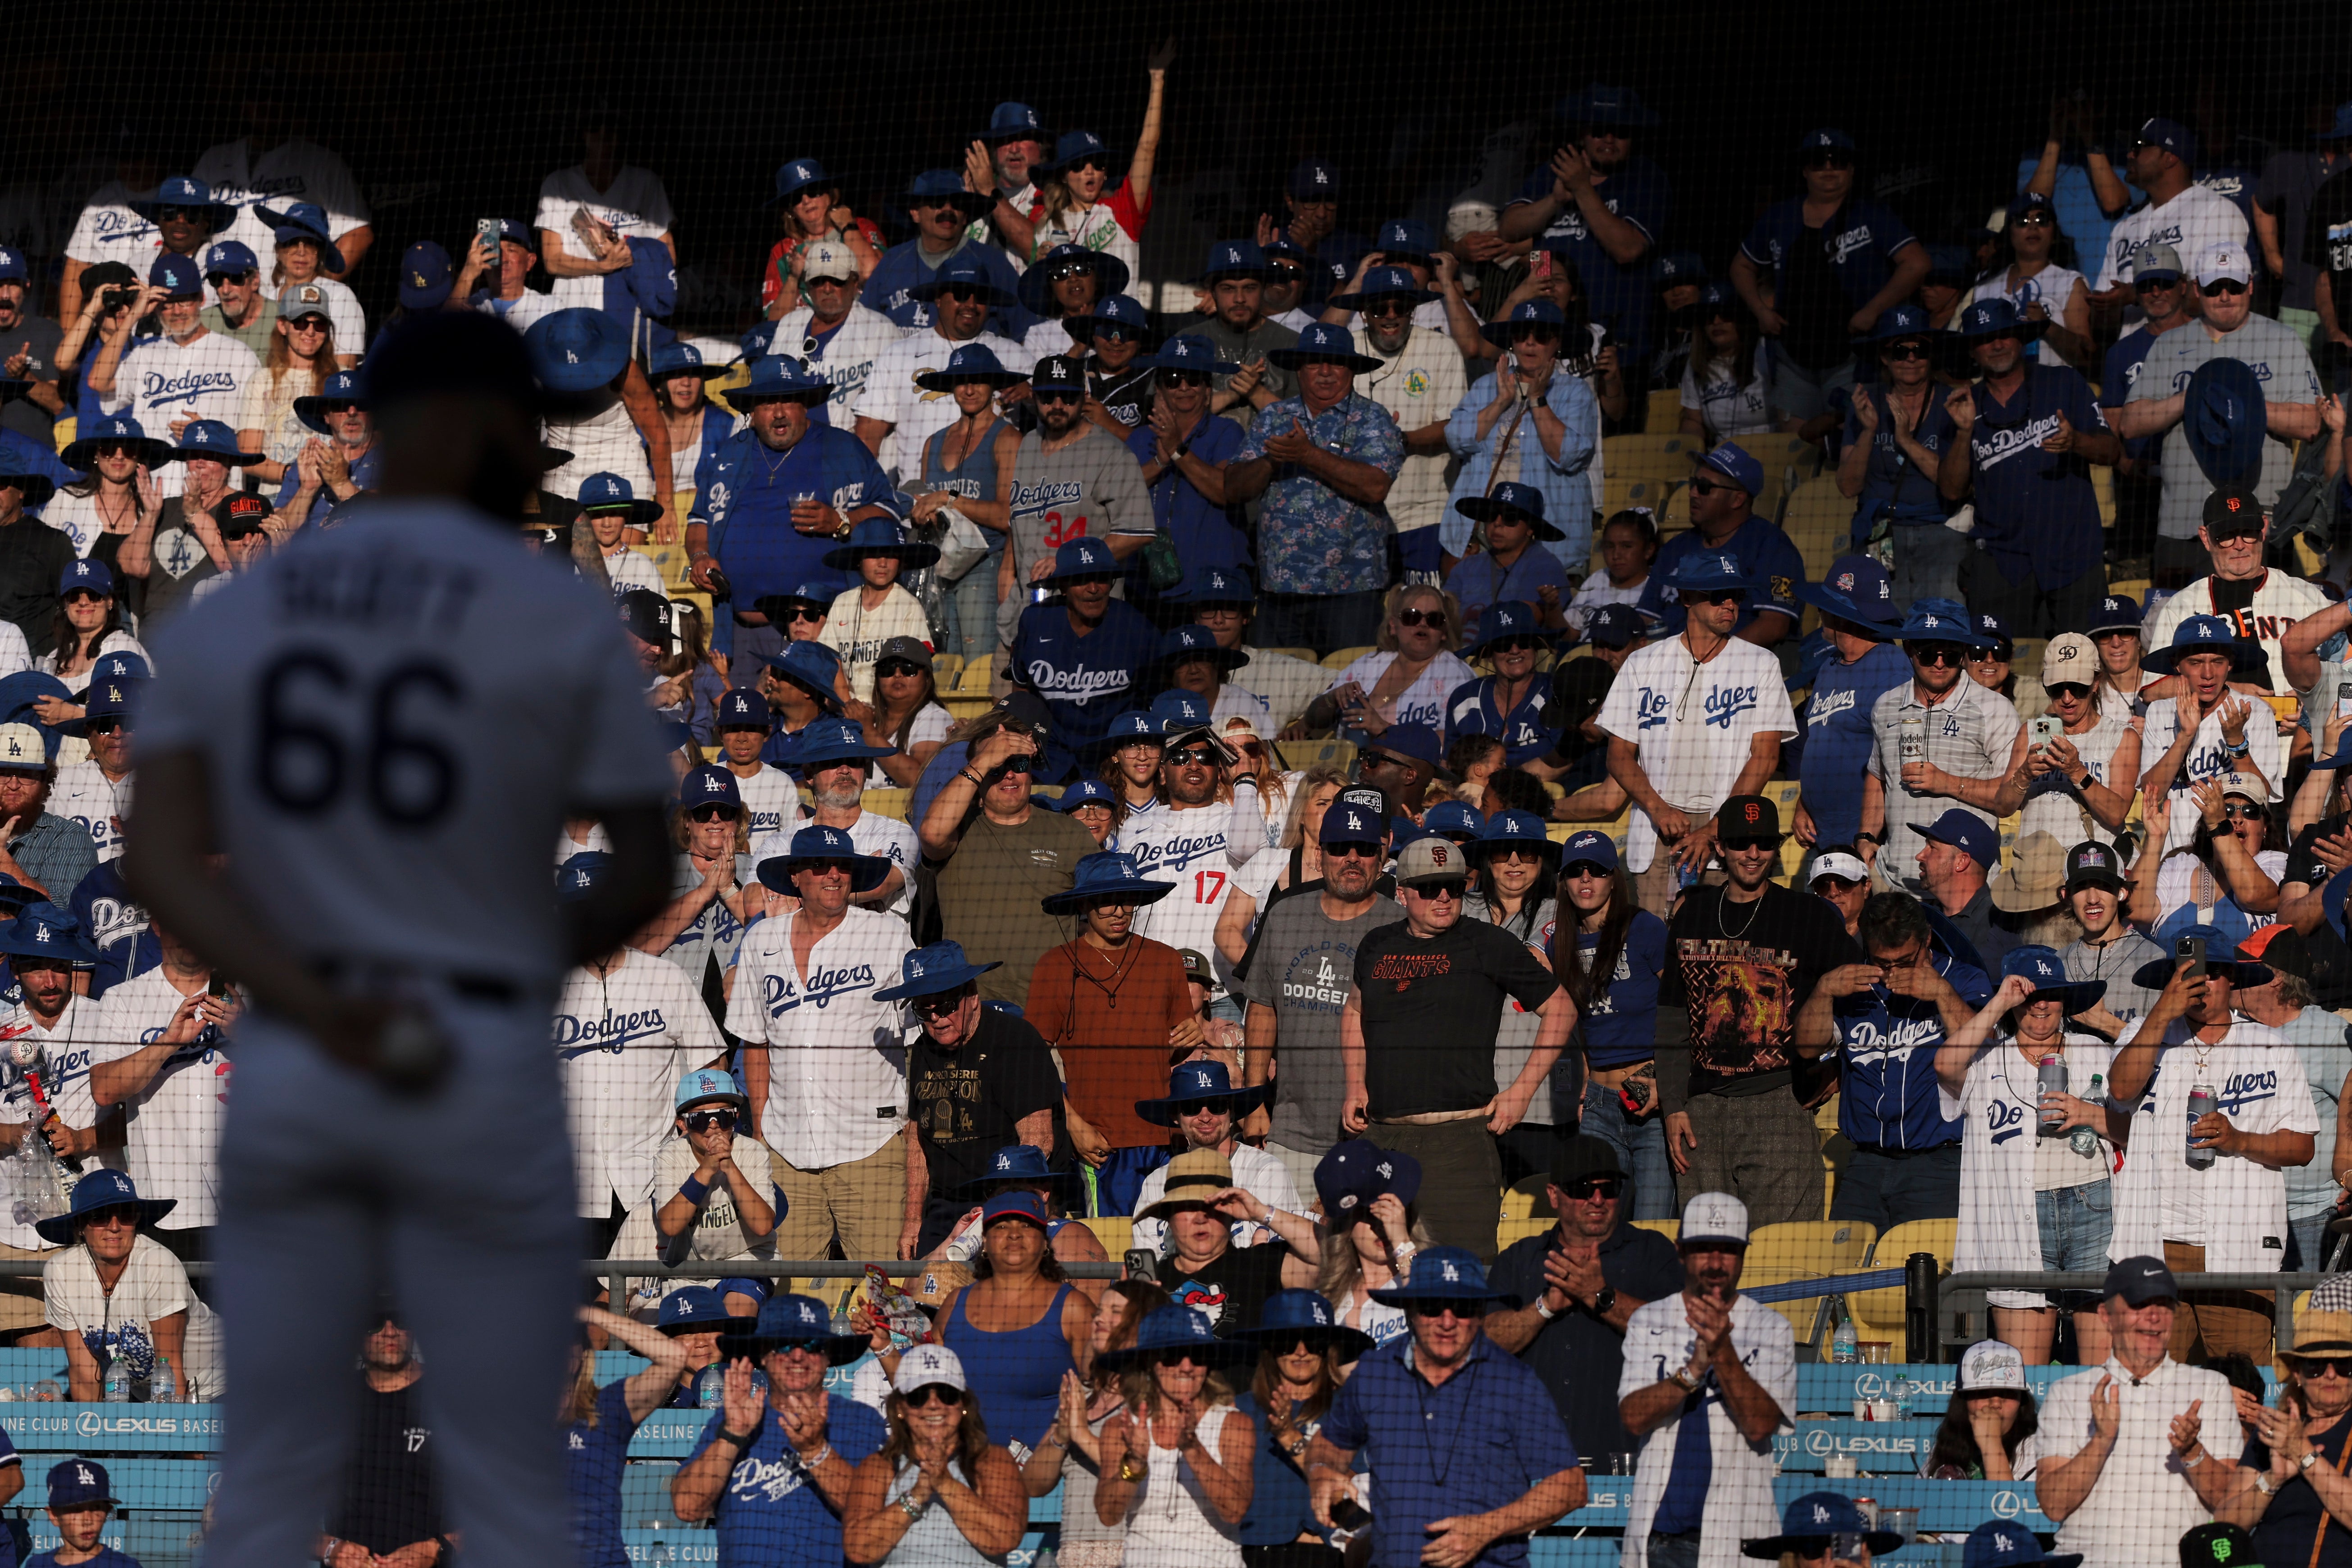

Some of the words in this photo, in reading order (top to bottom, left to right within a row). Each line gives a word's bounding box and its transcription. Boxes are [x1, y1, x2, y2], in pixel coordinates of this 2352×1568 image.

[1395, 225, 1407, 241] LA
[1229, 248, 1241, 263] LA
[2144, 251, 2156, 265] LA
[1391, 271, 1402, 285] LA
[1525, 304, 1537, 318] LA
[1978, 309, 1990, 324] LA
[1897, 313, 1909, 326] LA
[1315, 328, 1327, 344] LA
[1175, 340, 1187, 356] LA
[567, 350, 578, 364] LA
[780, 363, 792, 379] LA
[1051, 360, 1066, 378] LA
[143, 370, 236, 406] Dodgers
[339, 375, 351, 388] LA
[115, 421, 127, 434] LA
[196, 426, 208, 442] LA
[1992, 413, 2061, 452] Dodger
[607, 479, 619, 495] LA
[230, 497, 263, 513] GIANTS
[1044, 512, 1087, 548] 34
[169, 535, 191, 571] LA
[1080, 548, 1093, 564] LA
[77, 562, 89, 575] LA
[1720, 557, 1735, 573] LA
[1212, 573, 1224, 588] LA
[1879, 580, 1889, 598] LA
[2104, 599, 2118, 610] LA
[659, 606, 669, 623] LA
[1499, 611, 1512, 626] LA
[1598, 611, 1611, 624] LA
[1925, 614, 1938, 627] LA
[1983, 615, 1997, 628] LA
[2198, 623, 2211, 637] LA
[1181, 632, 1194, 645] LA
[113, 659, 126, 675] LA
[1028, 659, 1130, 706] Dodgers
[109, 685, 123, 701] LA
[736, 696, 748, 712] LA
[1182, 701, 1195, 717] LA
[1135, 718, 1149, 732] LA
[1943, 715, 1959, 736] LA
[252, 646, 469, 831] 66
[841, 727, 855, 743] LA
[1517, 723, 1538, 746] LA
[9, 737, 21, 756] LA
[705, 774, 719, 791] LA
[2228, 772, 2242, 784] LA
[1083, 782, 1096, 794] LA
[1348, 811, 1361, 830] LA
[1463, 810, 1474, 828] LA
[1506, 818, 1519, 832] LA
[823, 831, 838, 845] LA
[1574, 836, 1597, 848] Dodgers
[886, 842, 904, 864] LA
[1128, 831, 1227, 874] Dodgers
[1120, 861, 1134, 877] LA
[1824, 856, 1832, 868] LA
[576, 869, 590, 886] LA
[1195, 870, 1225, 904] 17
[36, 923, 50, 942] LA
[911, 959, 924, 977] LA
[1284, 940, 1330, 982] WORLD
[2036, 960, 2052, 975] LA
[1316, 957, 1335, 987] LA
[1372, 960, 1451, 979] GIANTS
[763, 963, 876, 1019] Dodgers
[553, 1008, 666, 1059] Dodgers
[950, 1069, 979, 1080] SERIE
[1197, 1071, 1212, 1087] LA
[997, 1154, 1010, 1169] LA
[1839, 1232, 1845, 1240] 2
[1442, 1260, 1459, 1282] LA
[923, 1273, 938, 1294] LA
[678, 1297, 692, 1315] LA
[1312, 1302, 1327, 1325] LA
[32, 1418, 68, 1431] CLUB
[104, 1418, 177, 1433] LEXUS
[184, 1420, 226, 1433] BASEL
[633, 1424, 694, 1439] ASELINE
[407, 1435, 425, 1452] 17
[1836, 1438, 1916, 1453] LEXUS
[77, 1464, 95, 1485] LA
